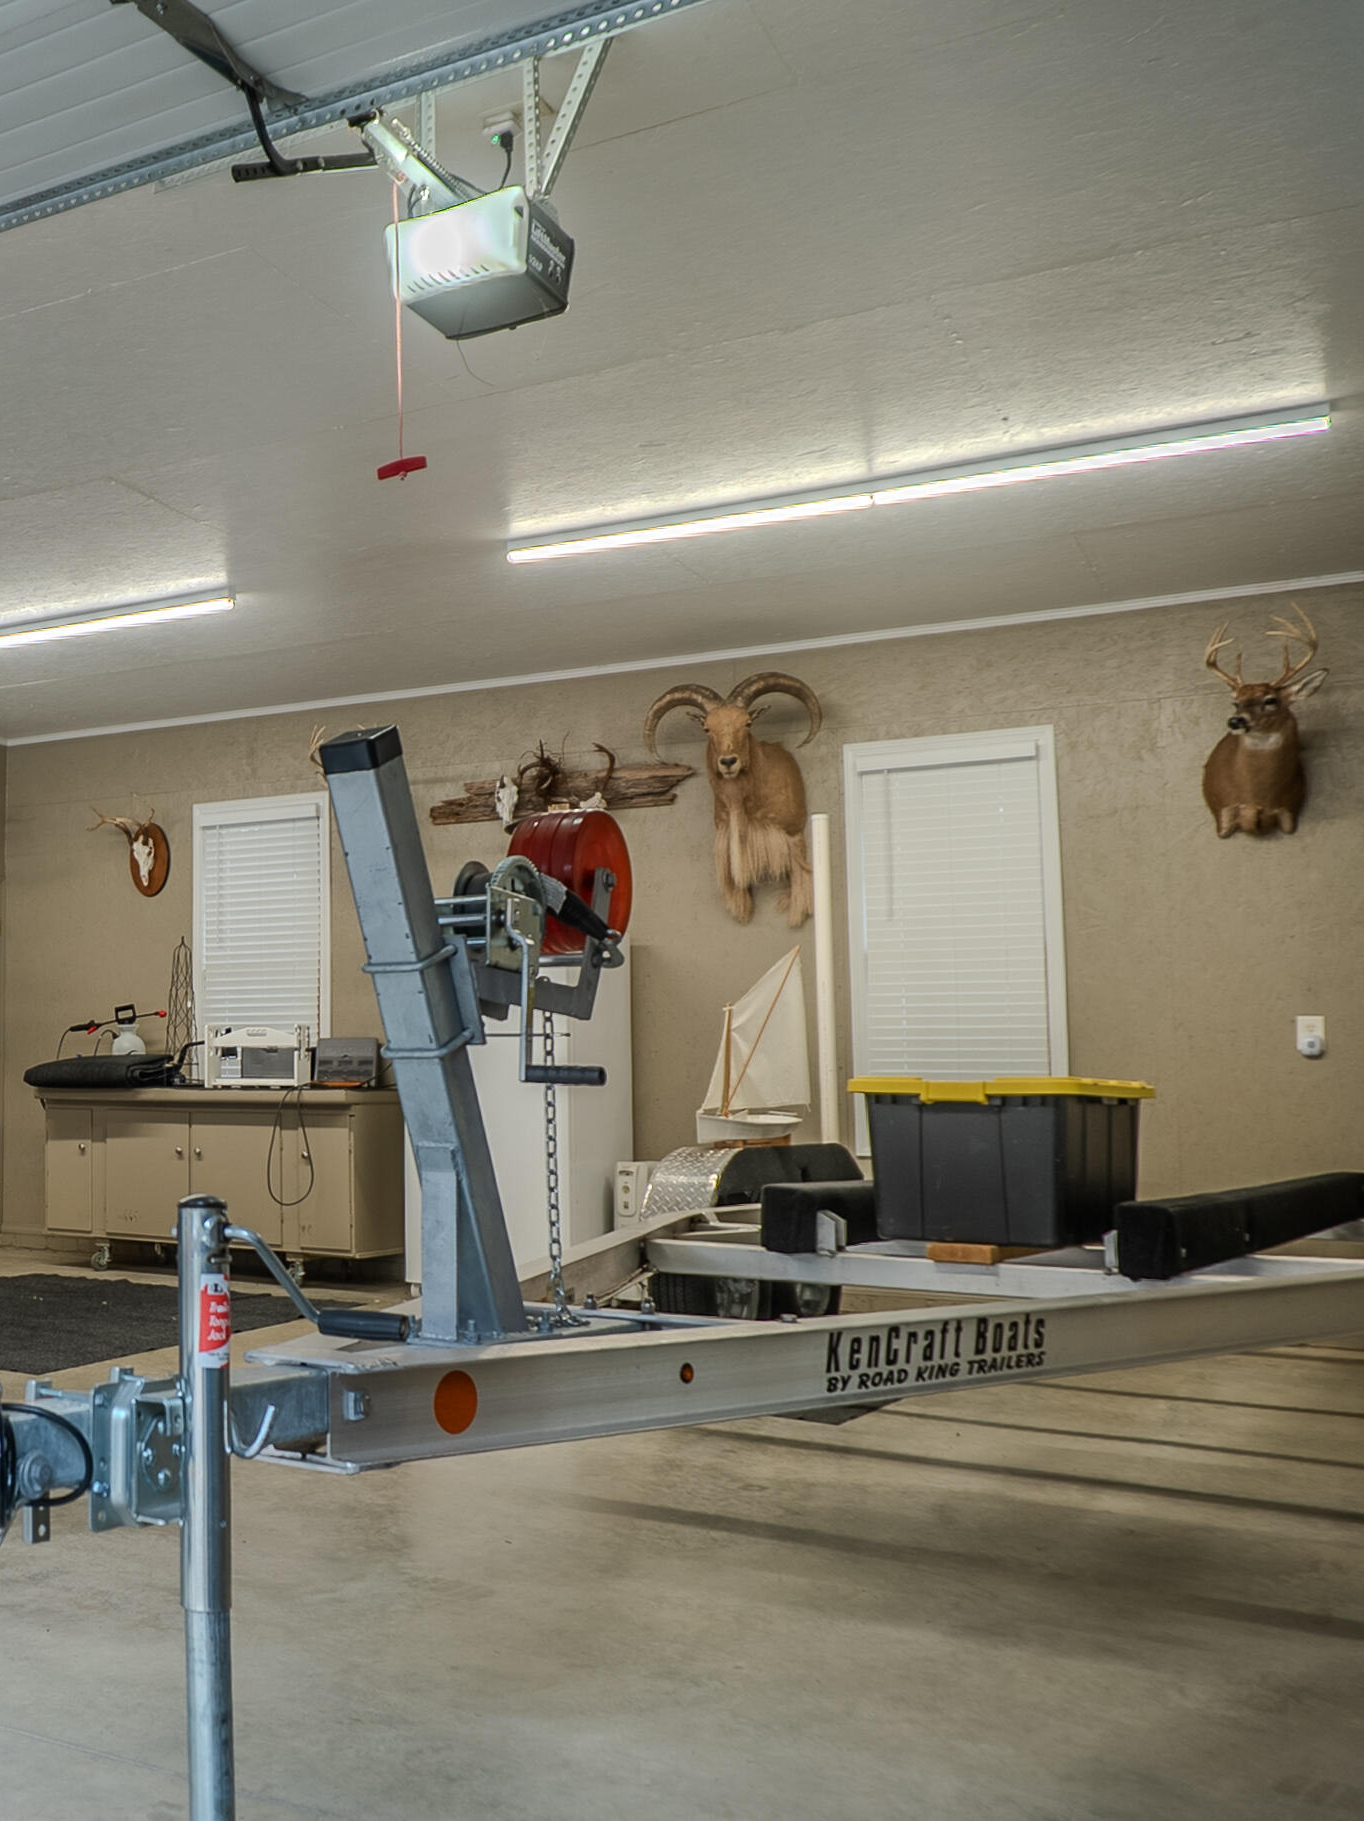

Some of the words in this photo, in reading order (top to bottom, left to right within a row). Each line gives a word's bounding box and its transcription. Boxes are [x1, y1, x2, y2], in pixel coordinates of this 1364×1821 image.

[826, 1319, 962, 1373] KenCraft
[974, 1313, 1045, 1355] Boats
[826, 1375, 851, 1393] BY
[857, 1369, 909, 1390] ROAD
[915, 1362, 961, 1382] KING
[966, 1351, 1046, 1376] TRAILERS
